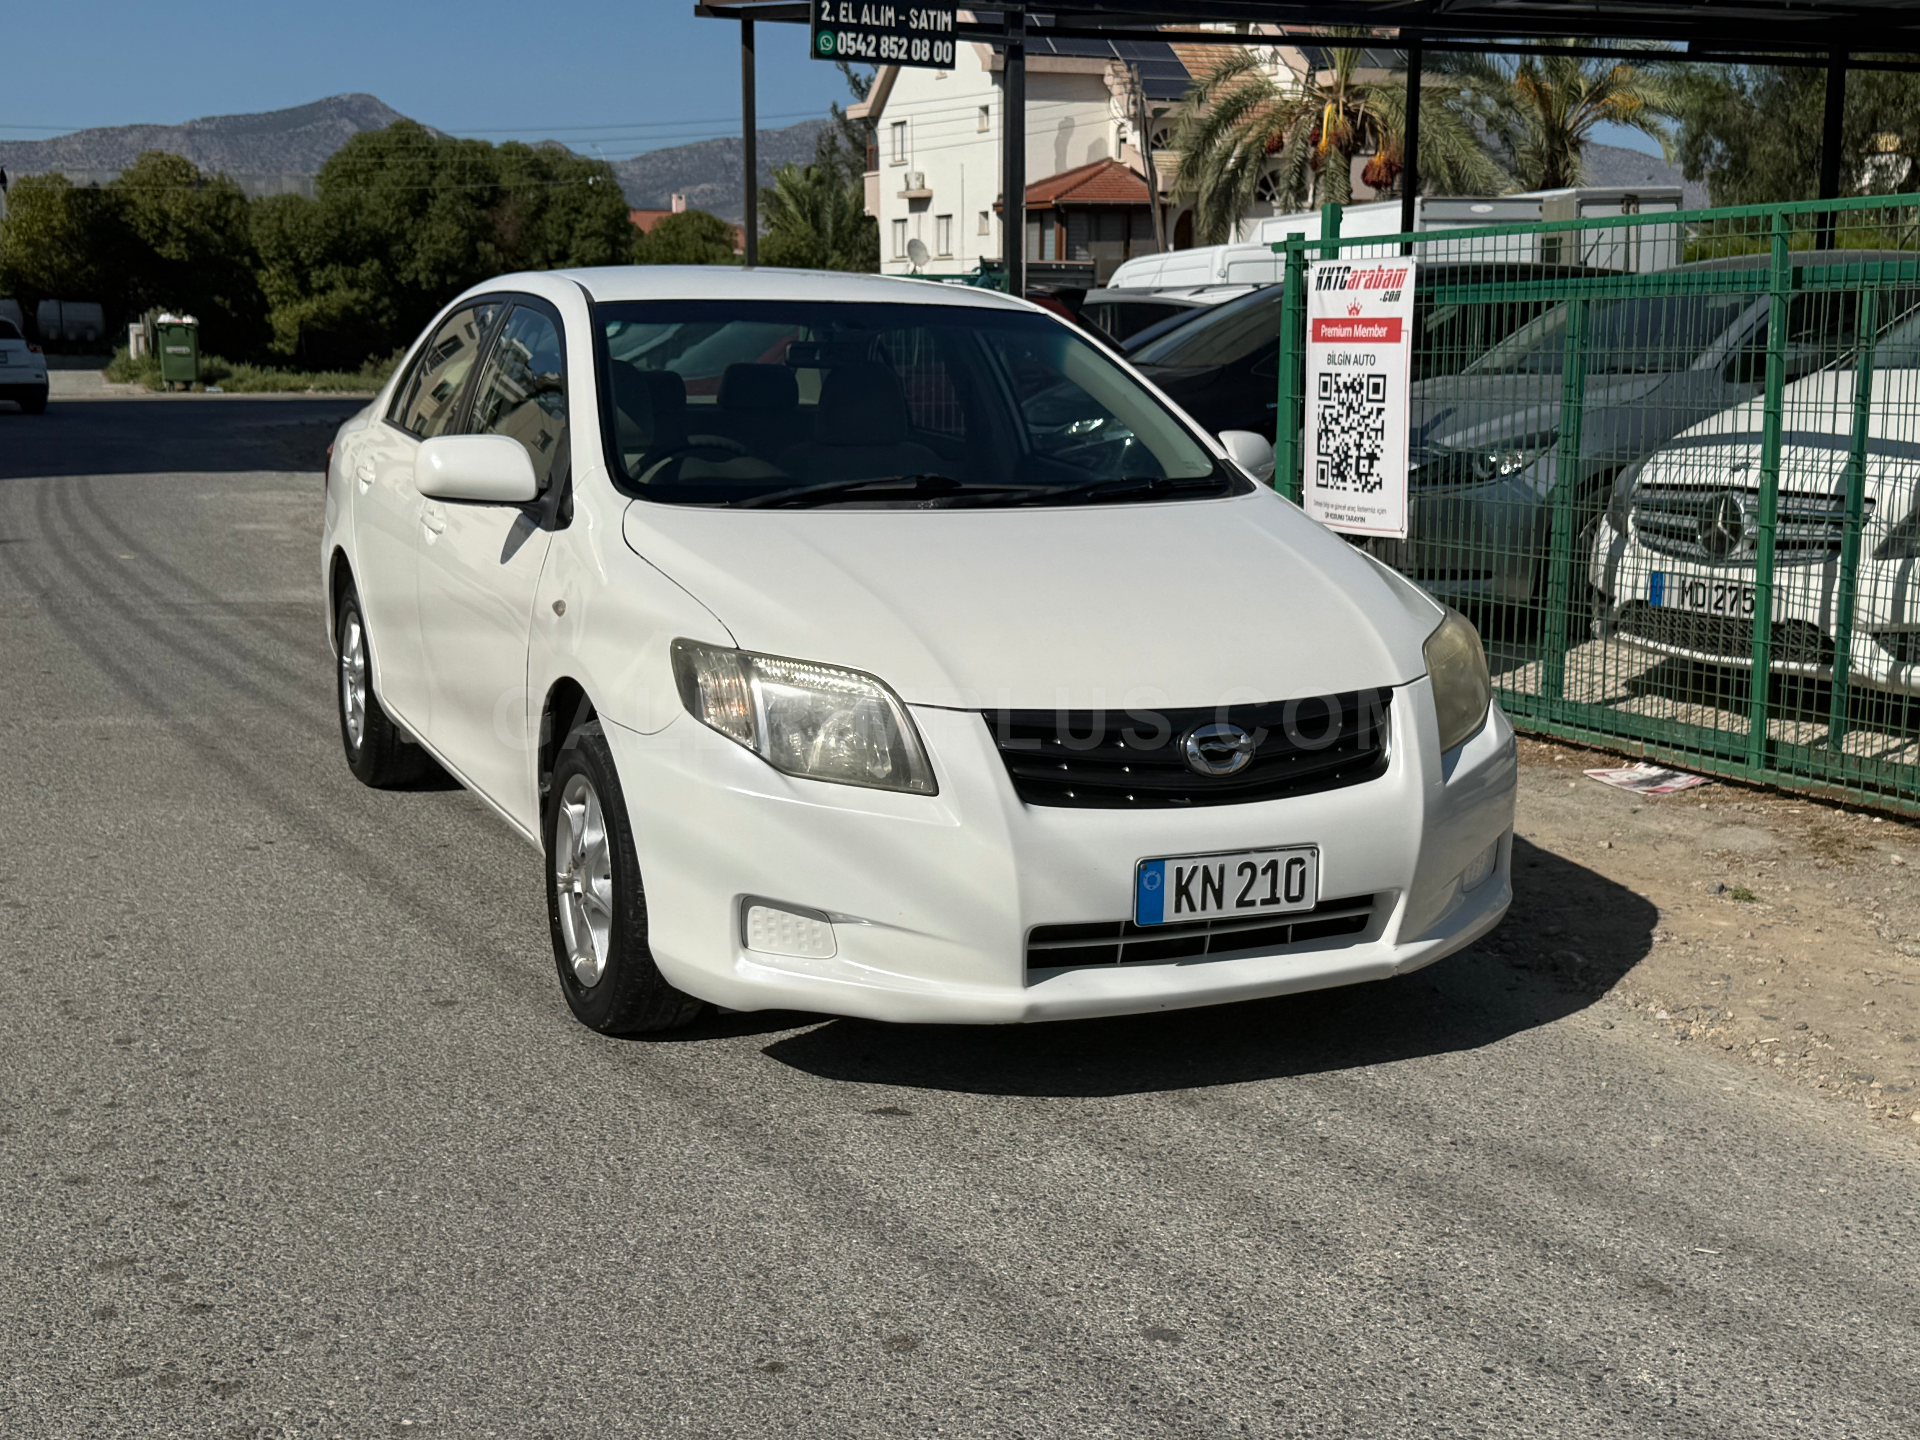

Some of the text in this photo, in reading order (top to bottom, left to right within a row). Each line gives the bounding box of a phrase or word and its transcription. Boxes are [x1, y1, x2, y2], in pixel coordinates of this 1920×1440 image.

[821, 1, 835, 23] 2.
[839, 2, 857, 24] EL
[861, 4, 896, 27] ALIM
[909, 8, 952, 32] SATIM
[837, 31, 953, 64] 0542 852 08 00
[1320, 323, 1388, 338] Premium Member
[1327, 350, 1376, 366] BİLGİN AUTO
[1680, 580, 1756, 614] MD 275
[1174, 857, 1307, 914] KN 210
